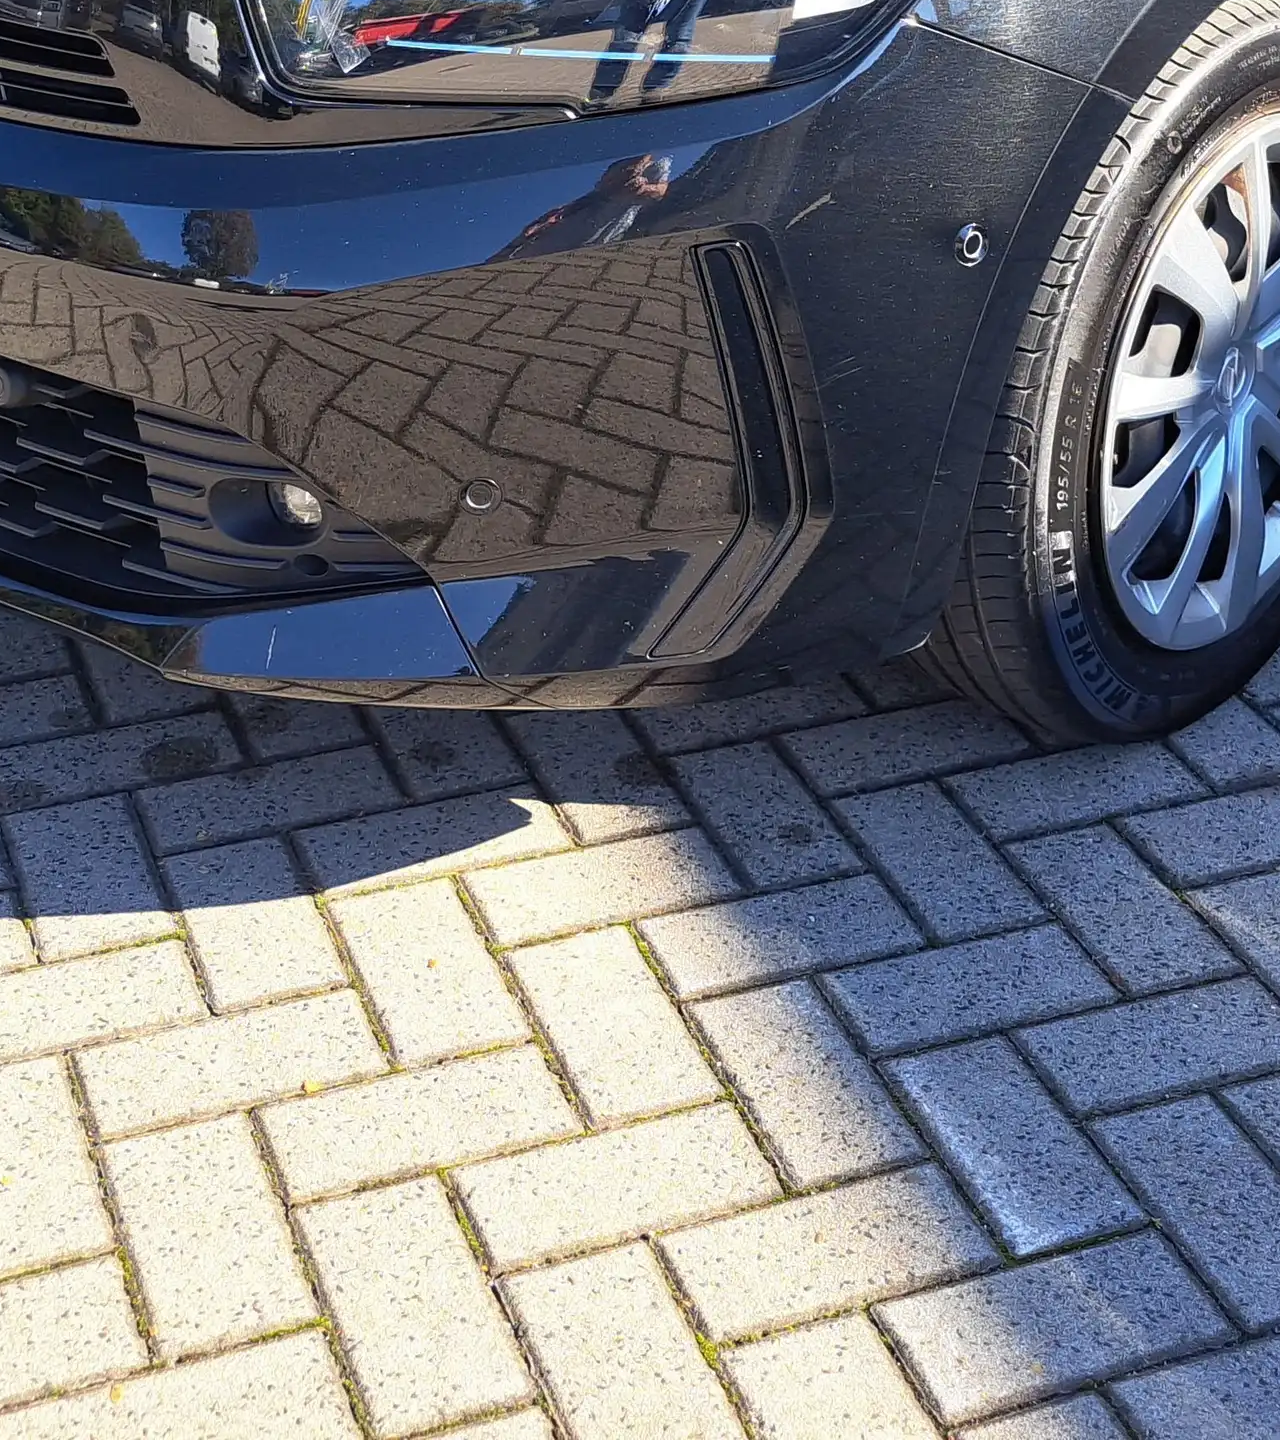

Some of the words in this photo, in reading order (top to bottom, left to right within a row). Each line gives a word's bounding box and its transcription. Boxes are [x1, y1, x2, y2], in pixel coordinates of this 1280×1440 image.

[1064, 415, 1077, 429] R
[1056, 435, 1074, 511] 195/55
[1053, 548, 1133, 711] MICHELIN
